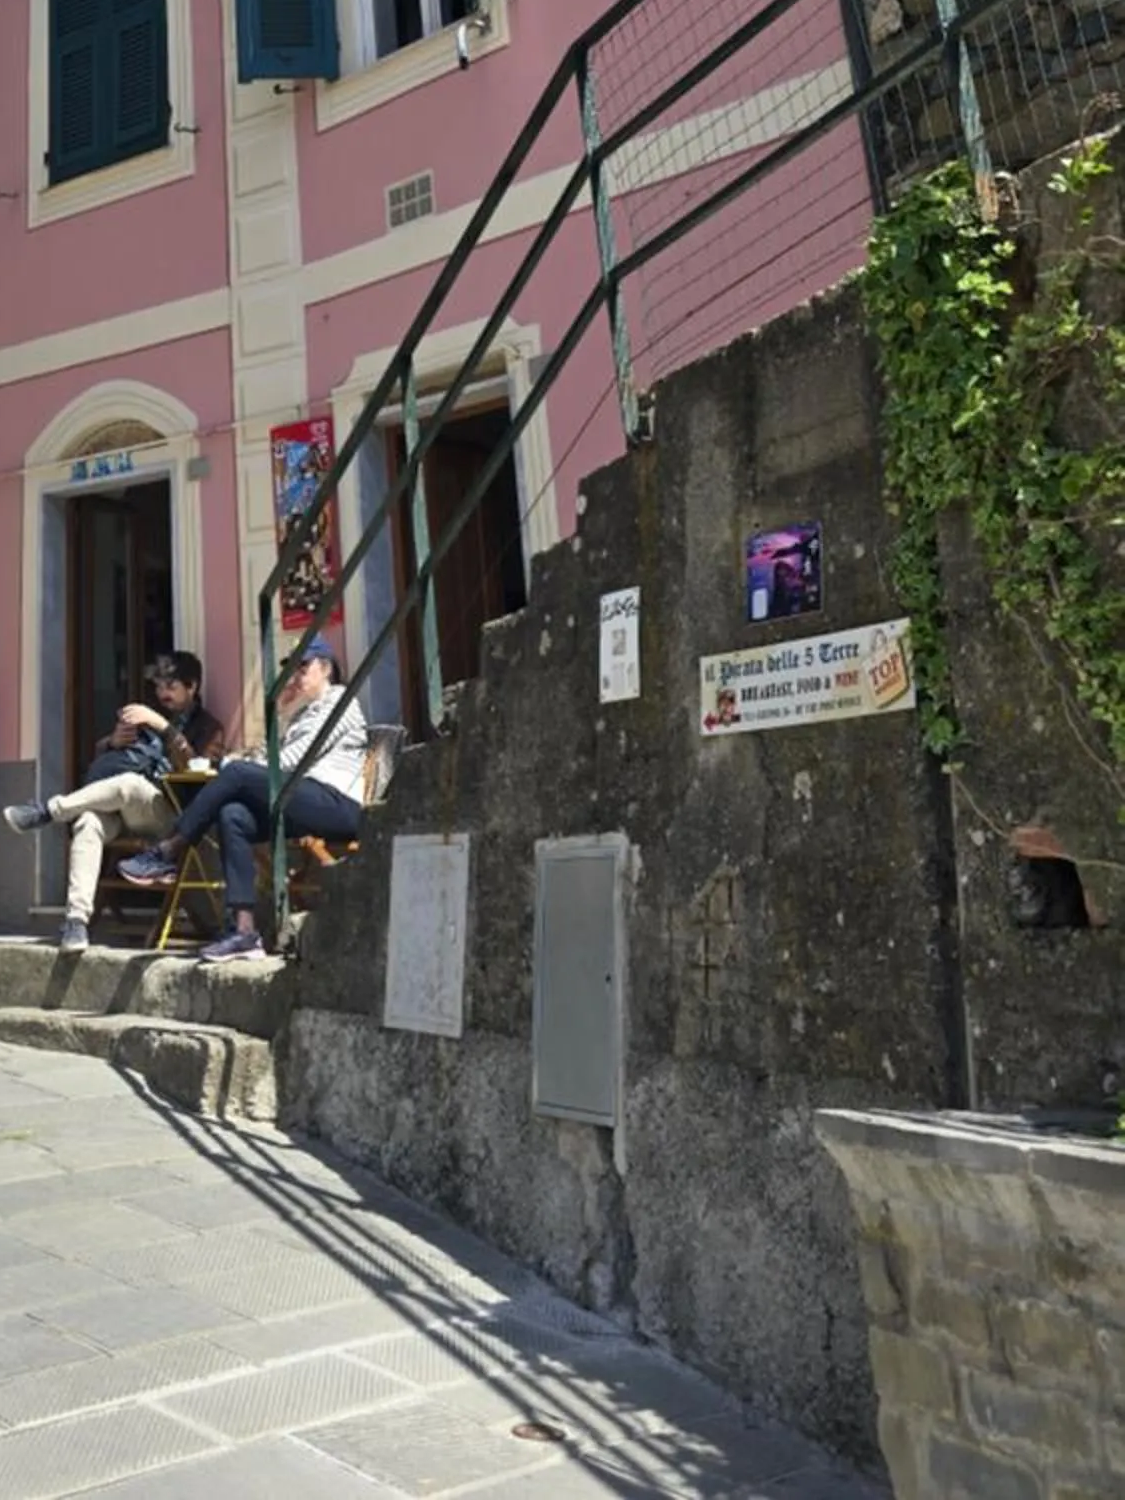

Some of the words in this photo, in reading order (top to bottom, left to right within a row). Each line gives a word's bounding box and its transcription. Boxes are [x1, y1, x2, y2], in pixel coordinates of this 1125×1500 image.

[720, 659, 763, 686] Pirata
[767, 650, 799, 672] delle
[804, 646, 813, 667] 5
[819, 642, 860, 663] Terre
[868, 652, 900, 686] TOP
